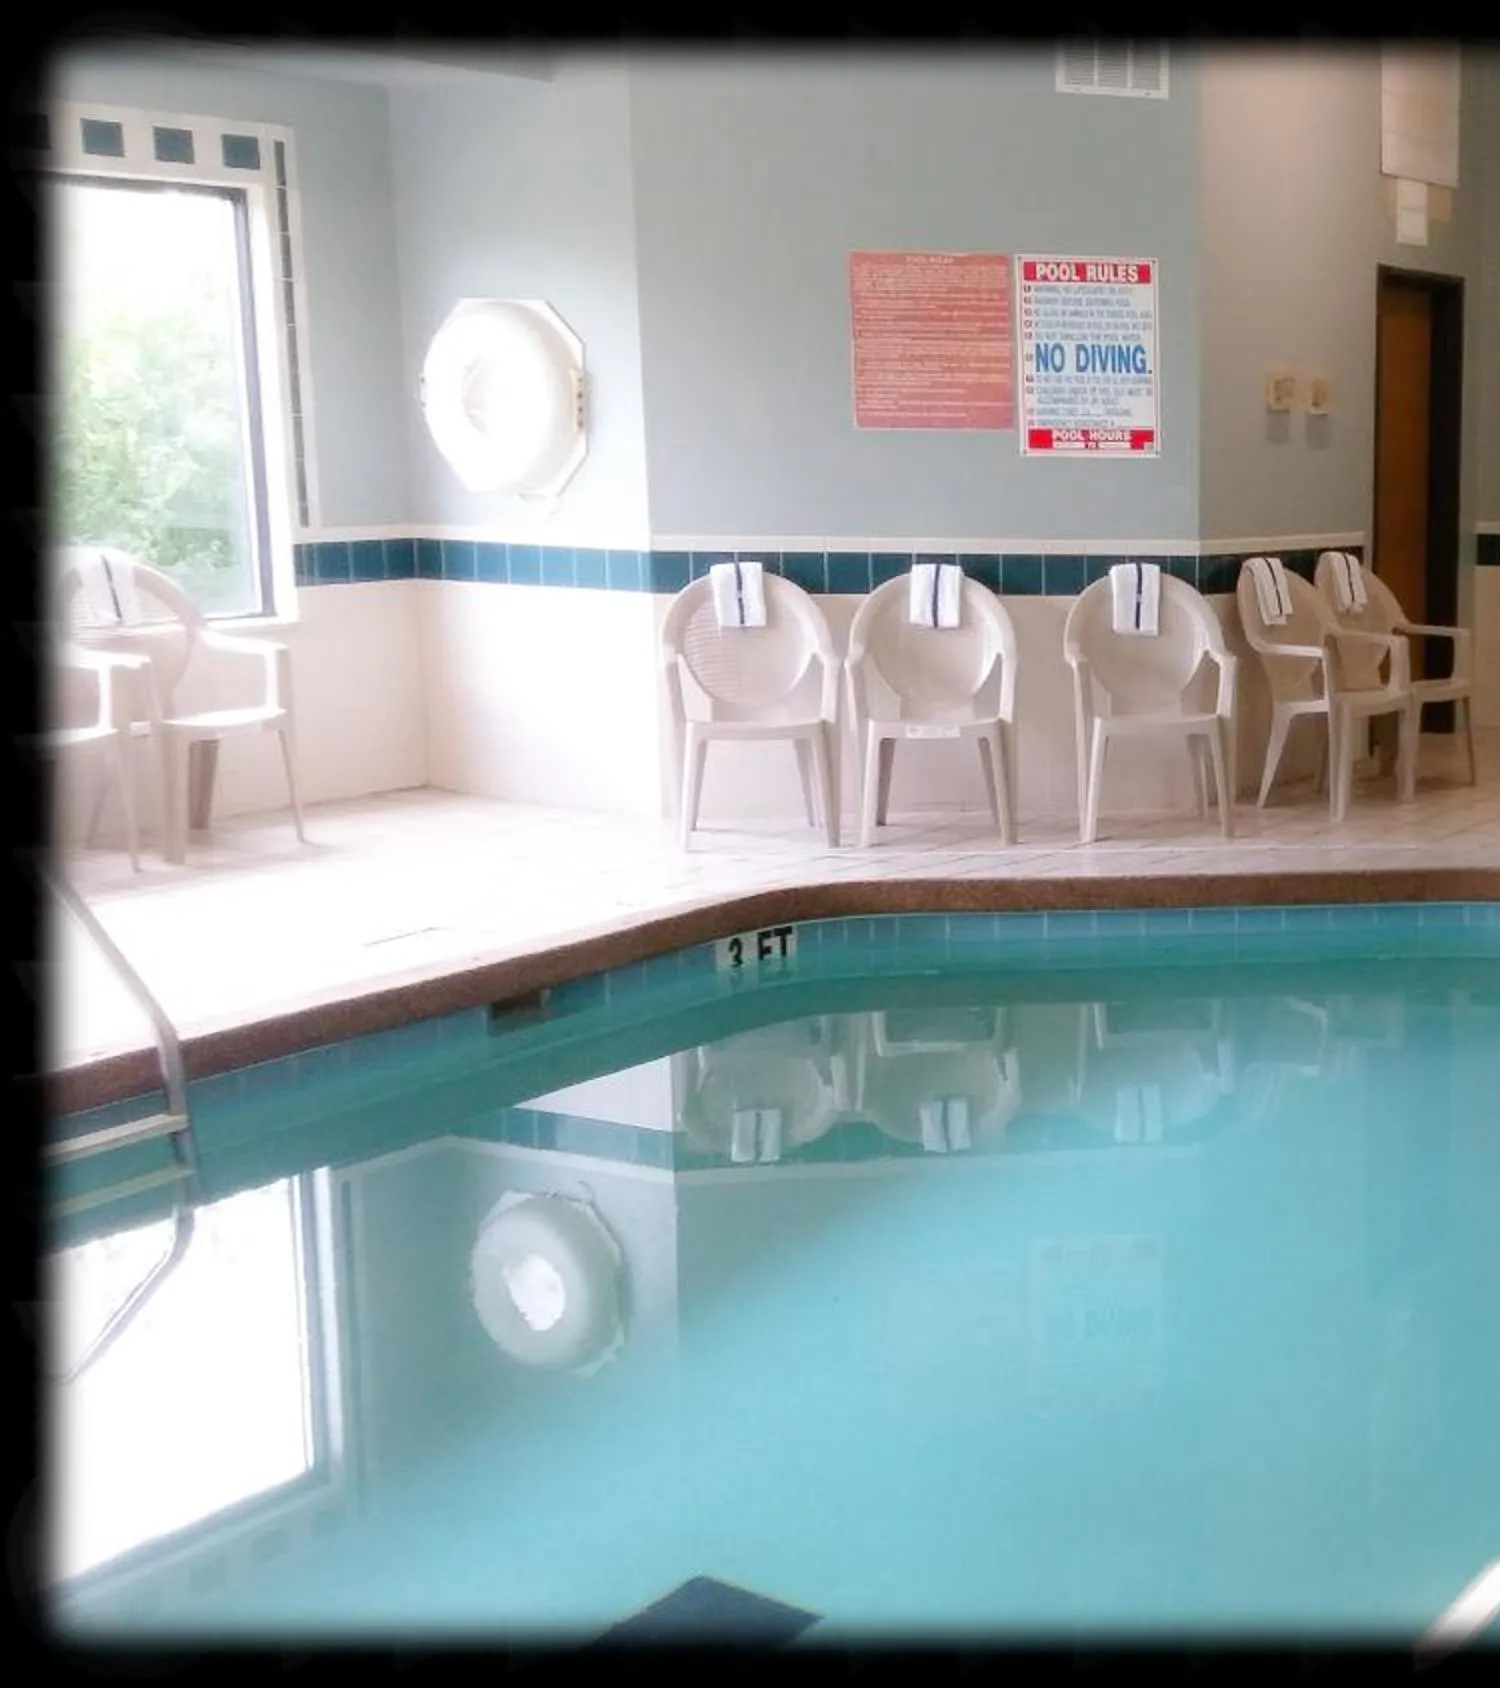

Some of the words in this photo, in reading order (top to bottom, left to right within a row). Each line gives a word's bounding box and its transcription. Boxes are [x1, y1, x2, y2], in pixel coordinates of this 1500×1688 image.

[1035, 262, 1081, 281] POOL
[1086, 264, 1138, 283] RULES
[1035, 343, 1065, 373] NO
[1075, 344, 1152, 374] DIVING.
[1053, 430, 1081, 441] POOL
[728, 937, 743, 968] 3
[757, 925, 793, 961] FT
